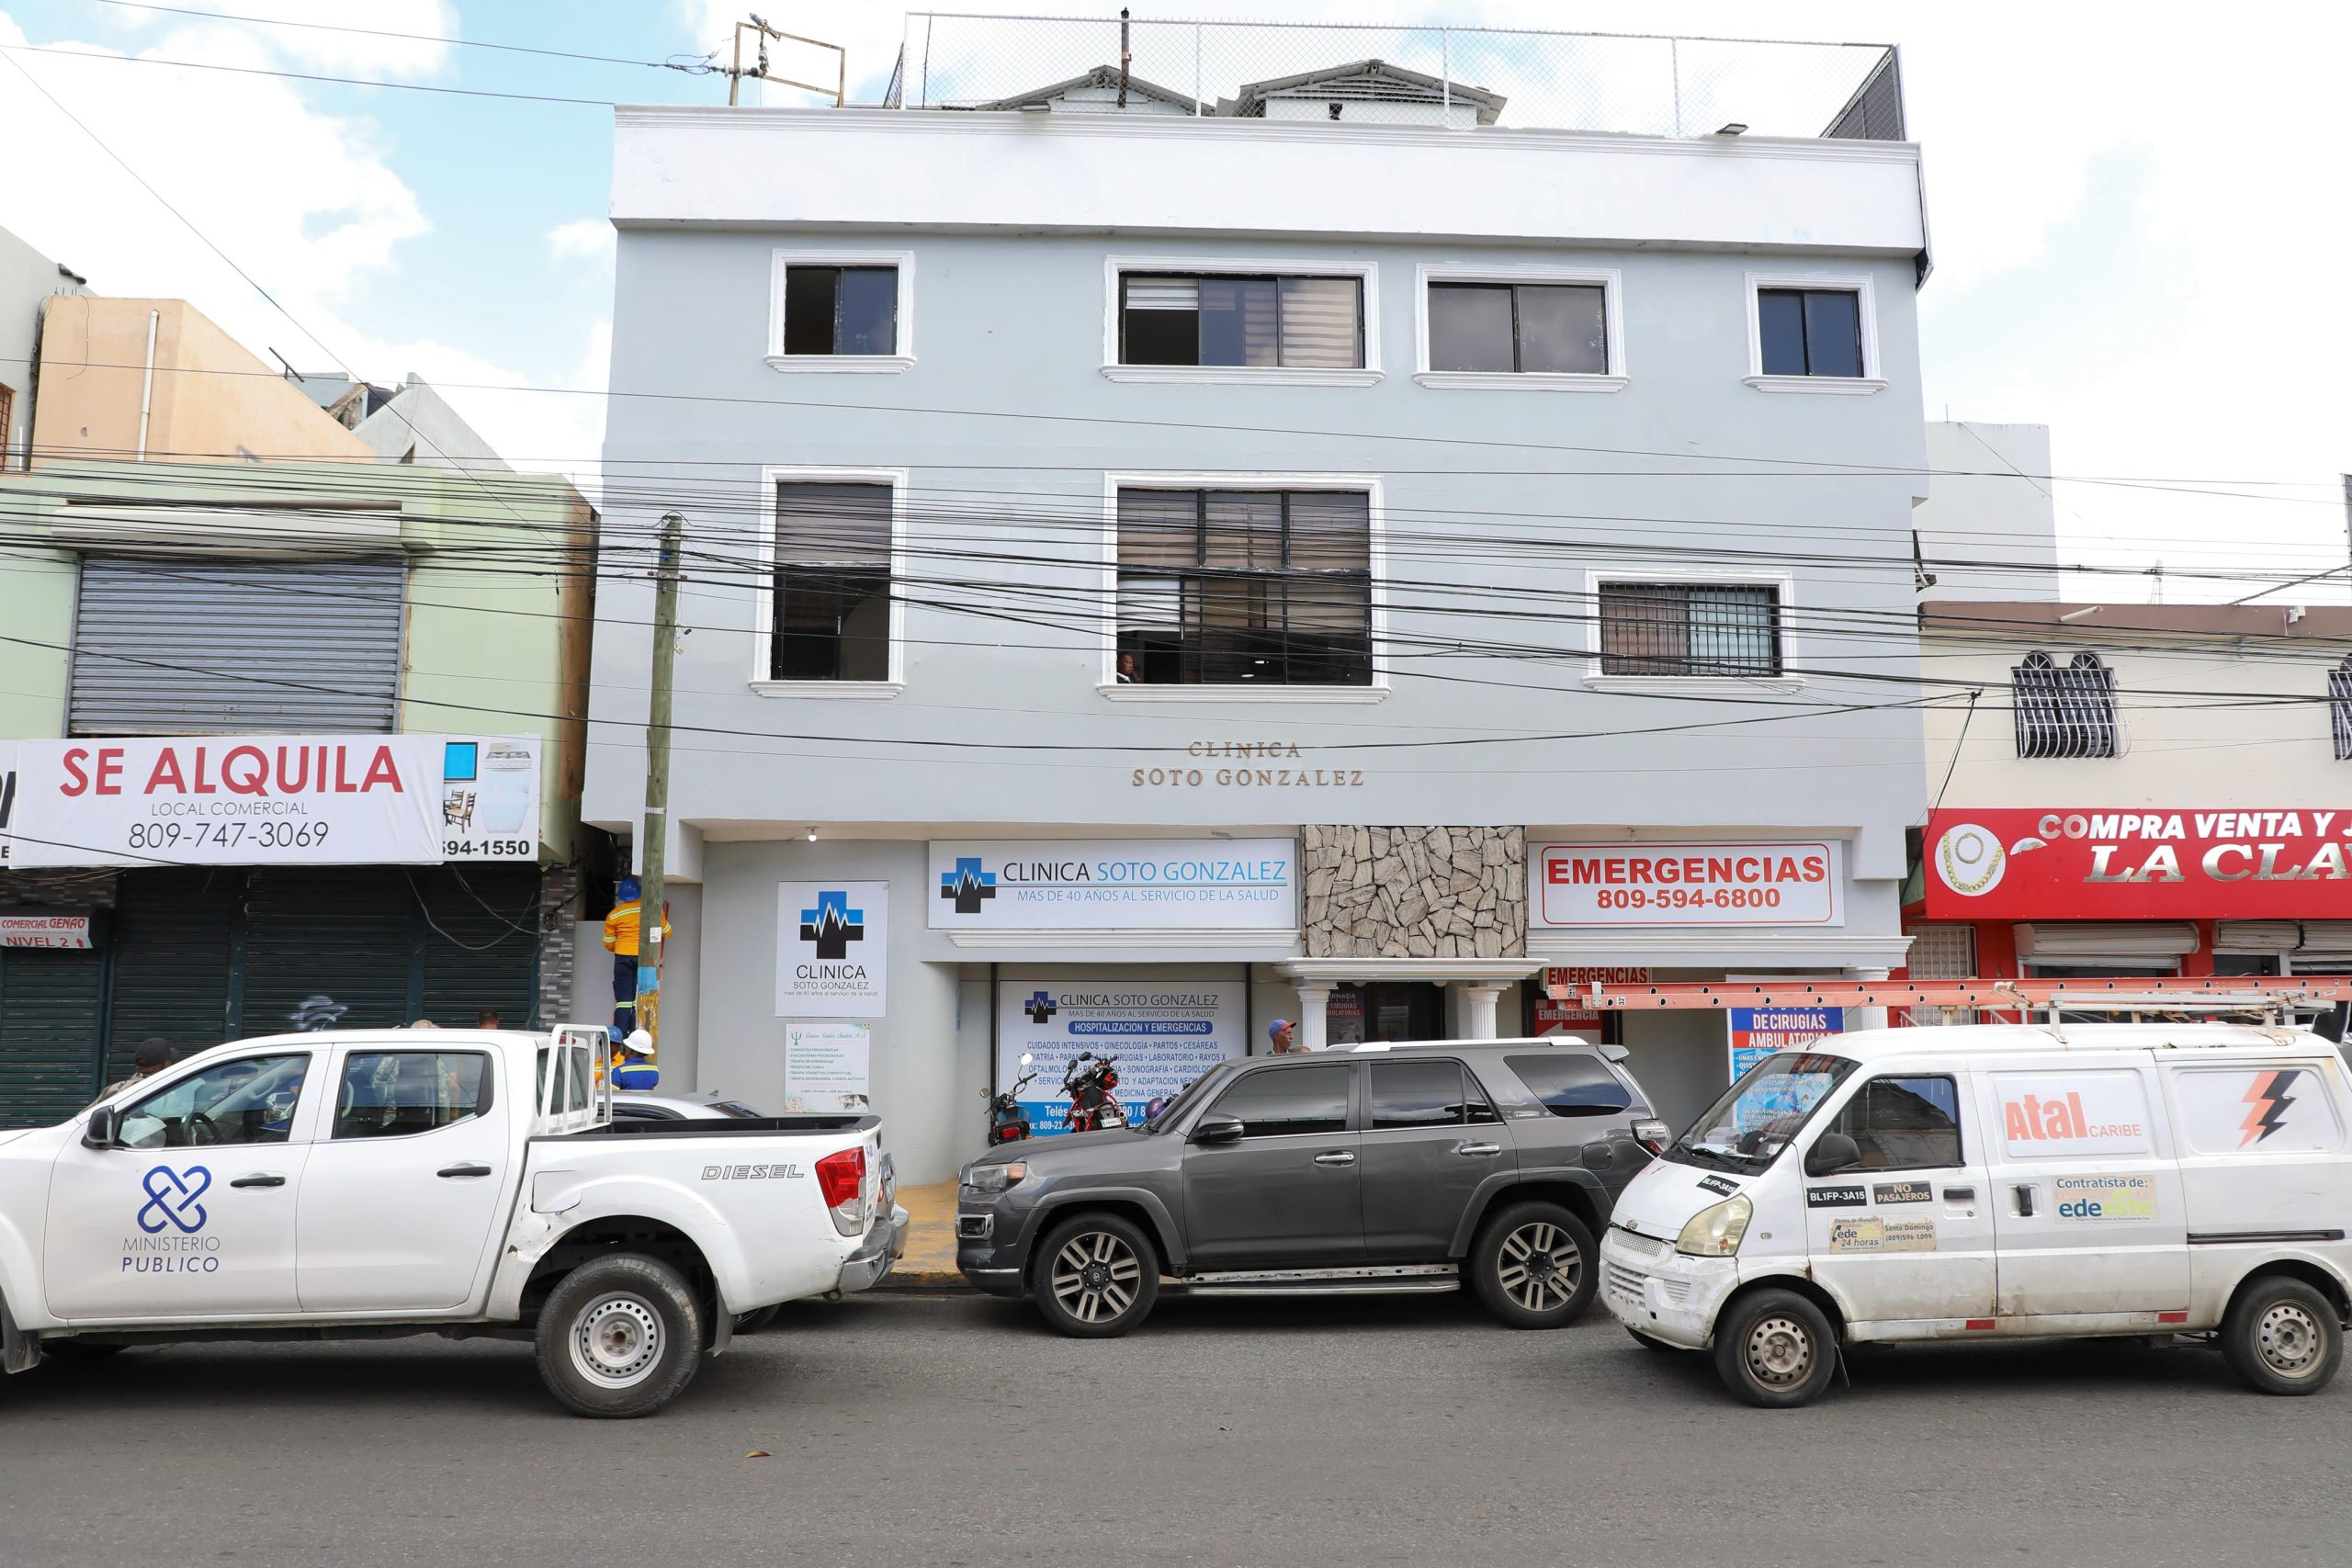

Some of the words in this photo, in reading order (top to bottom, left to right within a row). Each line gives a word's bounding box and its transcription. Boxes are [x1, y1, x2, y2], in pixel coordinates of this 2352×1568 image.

[1189, 741, 1302, 758] CLINICA
[60, 748, 124, 797] SE
[143, 746, 404, 797] ALQUILA
[1132, 768, 1203, 786] SOTO
[1216, 769, 1364, 786] GONZALEZ
[151, 801, 207, 817] LOCAL
[210, 801, 308, 816] COMERCIAL
[2038, 814, 2186, 840] COMPRA
[2194, 813, 2302, 838] VENTA
[2312, 812, 2335, 838] Y
[129, 822, 329, 849] 809-747-3069
[2083, 844, 2186, 883] LA
[2201, 842, 2352, 882] CLA
[1003, 862, 1091, 883] CLINICA
[1097, 862, 1157, 883] SOTO
[1163, 861, 1286, 882] GONZALEZ
[1547, 856, 1825, 885] EMERGENCIAS
[1017, 890, 1044, 902] MAS
[1047, 890, 1064, 902] DE
[1067, 890, 1081, 902] 40
[1084, 887, 1118, 902] AÑOS
[1122, 890, 1138, 902] AL
[1141, 890, 1195, 901] SERVICIO
[1200, 890, 1216, 901] DE
[1220, 889, 1235, 901] LA
[1238, 889, 1279, 901] SALUD
[1597, 887, 1781, 909] 809-594-6800
[2, 919, 48, 930] COMERCIAL
[50, 919, 86, 930] GENAO
[6, 937, 55, 947] NIVEL
[60, 937, 70, 947] 2
[797, 964, 866, 979] CLINICA
[1548, 967, 1648, 986] EMERGENCIAS
[793, 981, 819, 989] SOTO
[820, 981, 869, 990] GONZALEZ
[1060, 994, 1110, 1006] CLINICA
[1114, 994, 1147, 1006] SOTO
[1150, 994, 1218, 1006] GONZALEZ
[1107, 1009, 1126, 1017] AÑOS
[1538, 1010, 1599, 1021] EMERGENCIA
[1074, 1022, 1143, 1032] HOSPITALIZACION
[1145, 1022, 1149, 1032] Y
[1151, 1022, 1206, 1032] EMERGENCIAS
[1752, 1013, 1769, 1030] DE
[1770, 1013, 1826, 1030] CIRUGIAS
[1027, 1041, 1060, 1050] CUIDADOS
[1061, 1041, 1099, 1050] INTENSIVOS
[1104, 1040, 1148, 1050] GINECOLOGÍA
[1153, 1042, 1178, 1050] PARTOS
[1183, 1040, 1218, 1050] CESÁREAS
[1148, 1053, 1194, 1061] LABORATORIO
[1127, 1063, 1169, 1073] SONOGRAFÍA
[1114, 1089, 1145, 1097] MEDICINA
[2005, 1091, 2088, 1141] Atal
[2089, 1123, 2143, 1138] CARIBE
[701, 1164, 804, 1180] DIESEL
[1893, 1184, 1911, 1193] NO
[2056, 1178, 2126, 1188] Contratista
[2129, 1177, 2148, 1188] de:
[1810, 1191, 1865, 1201] BL1FP-3A15
[1877, 1191, 1930, 1203] PASAJEROS
[122, 1236, 220, 1251] MINISTERIO
[1841, 1238, 1851, 1247] 24
[1854, 1238, 1879, 1247] horas
[121, 1257, 219, 1273] PUBLICO
